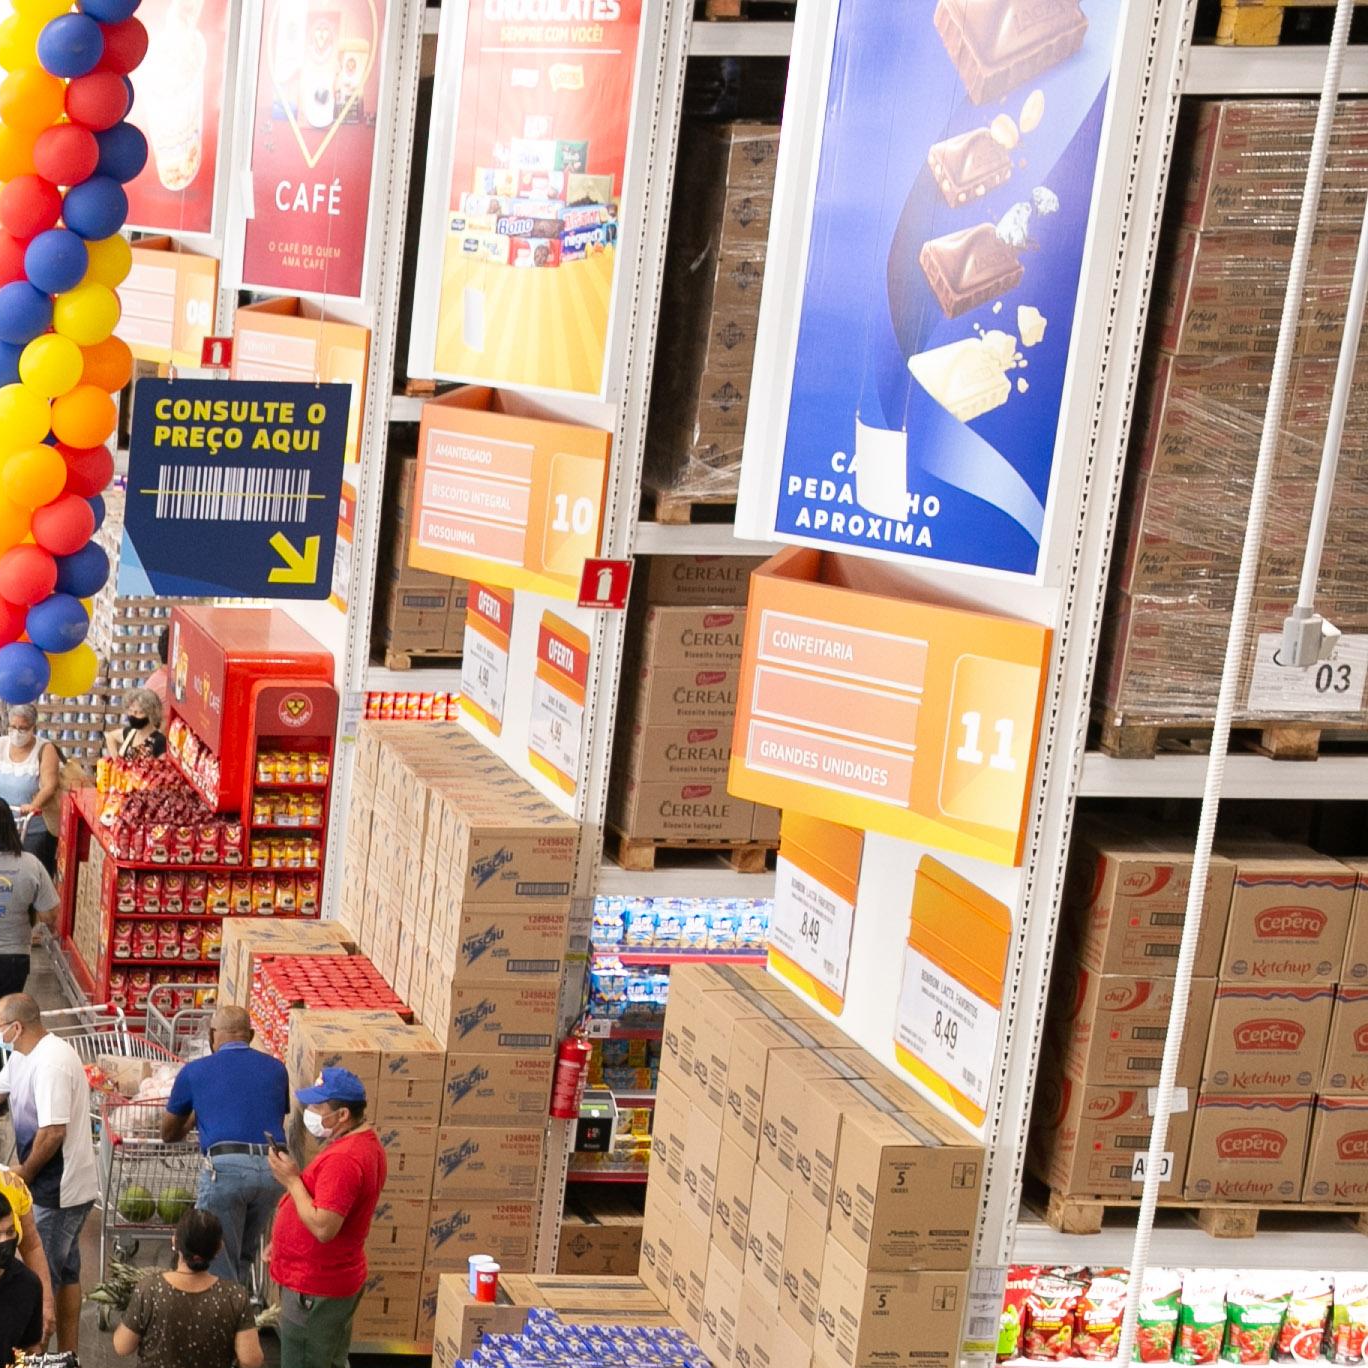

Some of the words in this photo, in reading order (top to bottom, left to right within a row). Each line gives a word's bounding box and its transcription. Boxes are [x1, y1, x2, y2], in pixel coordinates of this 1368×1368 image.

[546, 26, 568, 42] COM
[275, 178, 343, 216] CAFÉ
[278, 240, 300, 254] CAFÉ
[302, 244, 313, 255] DE
[315, 245, 341, 258] QUEM
[282, 256, 300, 267] AMA
[302, 256, 325, 270] CAFÉ
[155, 399, 294, 424] CONSULTE
[307, 403, 326, 424] O
[154, 426, 243, 455] PREÇO
[252, 429, 320, 453] AQUI
[436, 442, 492, 466] AMANTEIGADO
[432, 484, 469, 504] BISCOITO
[471, 490, 511, 511] INTEGRAL
[551, 493, 594, 535] 10
[796, 507, 933, 548] APROXIMA
[428, 524, 476, 547] ROSQUINHA
[478, 590, 501, 624] OFERTA
[548, 637, 575, 673] OFERTA
[772, 630, 853, 661] CONFEITARIA
[1315, 664, 1352, 693] 03
[956, 712, 1016, 772] 11
[760, 740, 818, 770] GRANDES
[822, 755, 889, 787] UNIDADES
[801, 911, 820, 945] 8,49
[1251, 960, 1311, 976] Ketchup
[934, 1010, 958, 1050] 8,49
[1232, 1073, 1291, 1089] Ketchup
[897, 1171, 906, 1187] 5
[1215, 1180, 1273, 1196] Ketchup
[878, 1294, 886, 1308] 5
